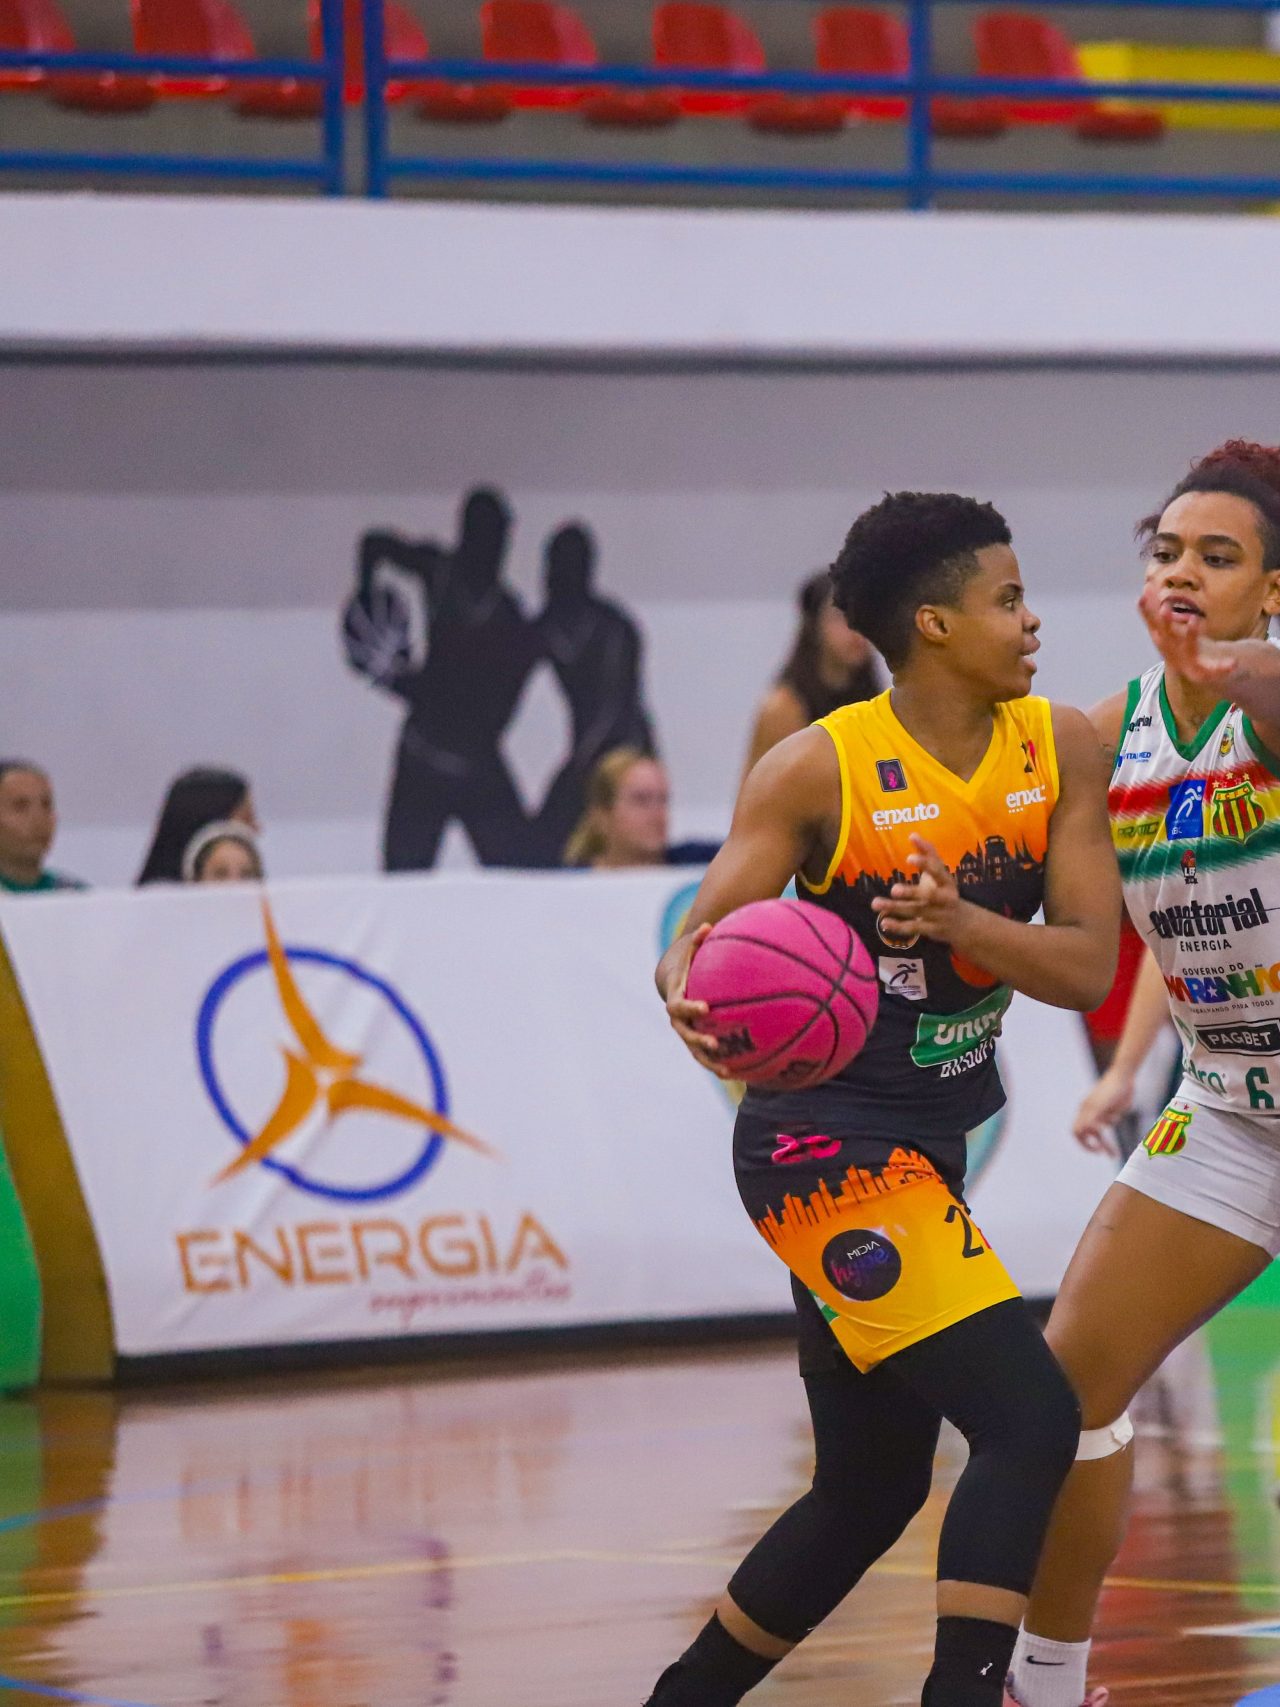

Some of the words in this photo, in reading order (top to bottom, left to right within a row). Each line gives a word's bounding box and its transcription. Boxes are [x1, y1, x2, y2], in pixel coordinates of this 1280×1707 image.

[872, 802, 940, 826] enxuto
[1180, 939, 1233, 952] ENERGIA
[1182, 965, 1226, 976] GOVERNO
[1229, 962, 1244, 971] DO
[1252, 999, 1274, 1008] TODOS
[1207, 1031, 1271, 1047] PAGBET
[1246, 1067, 1275, 1110] 6
[176, 1212, 569, 1293] ENERGIA
[847, 1241, 880, 1260] MIDIA
